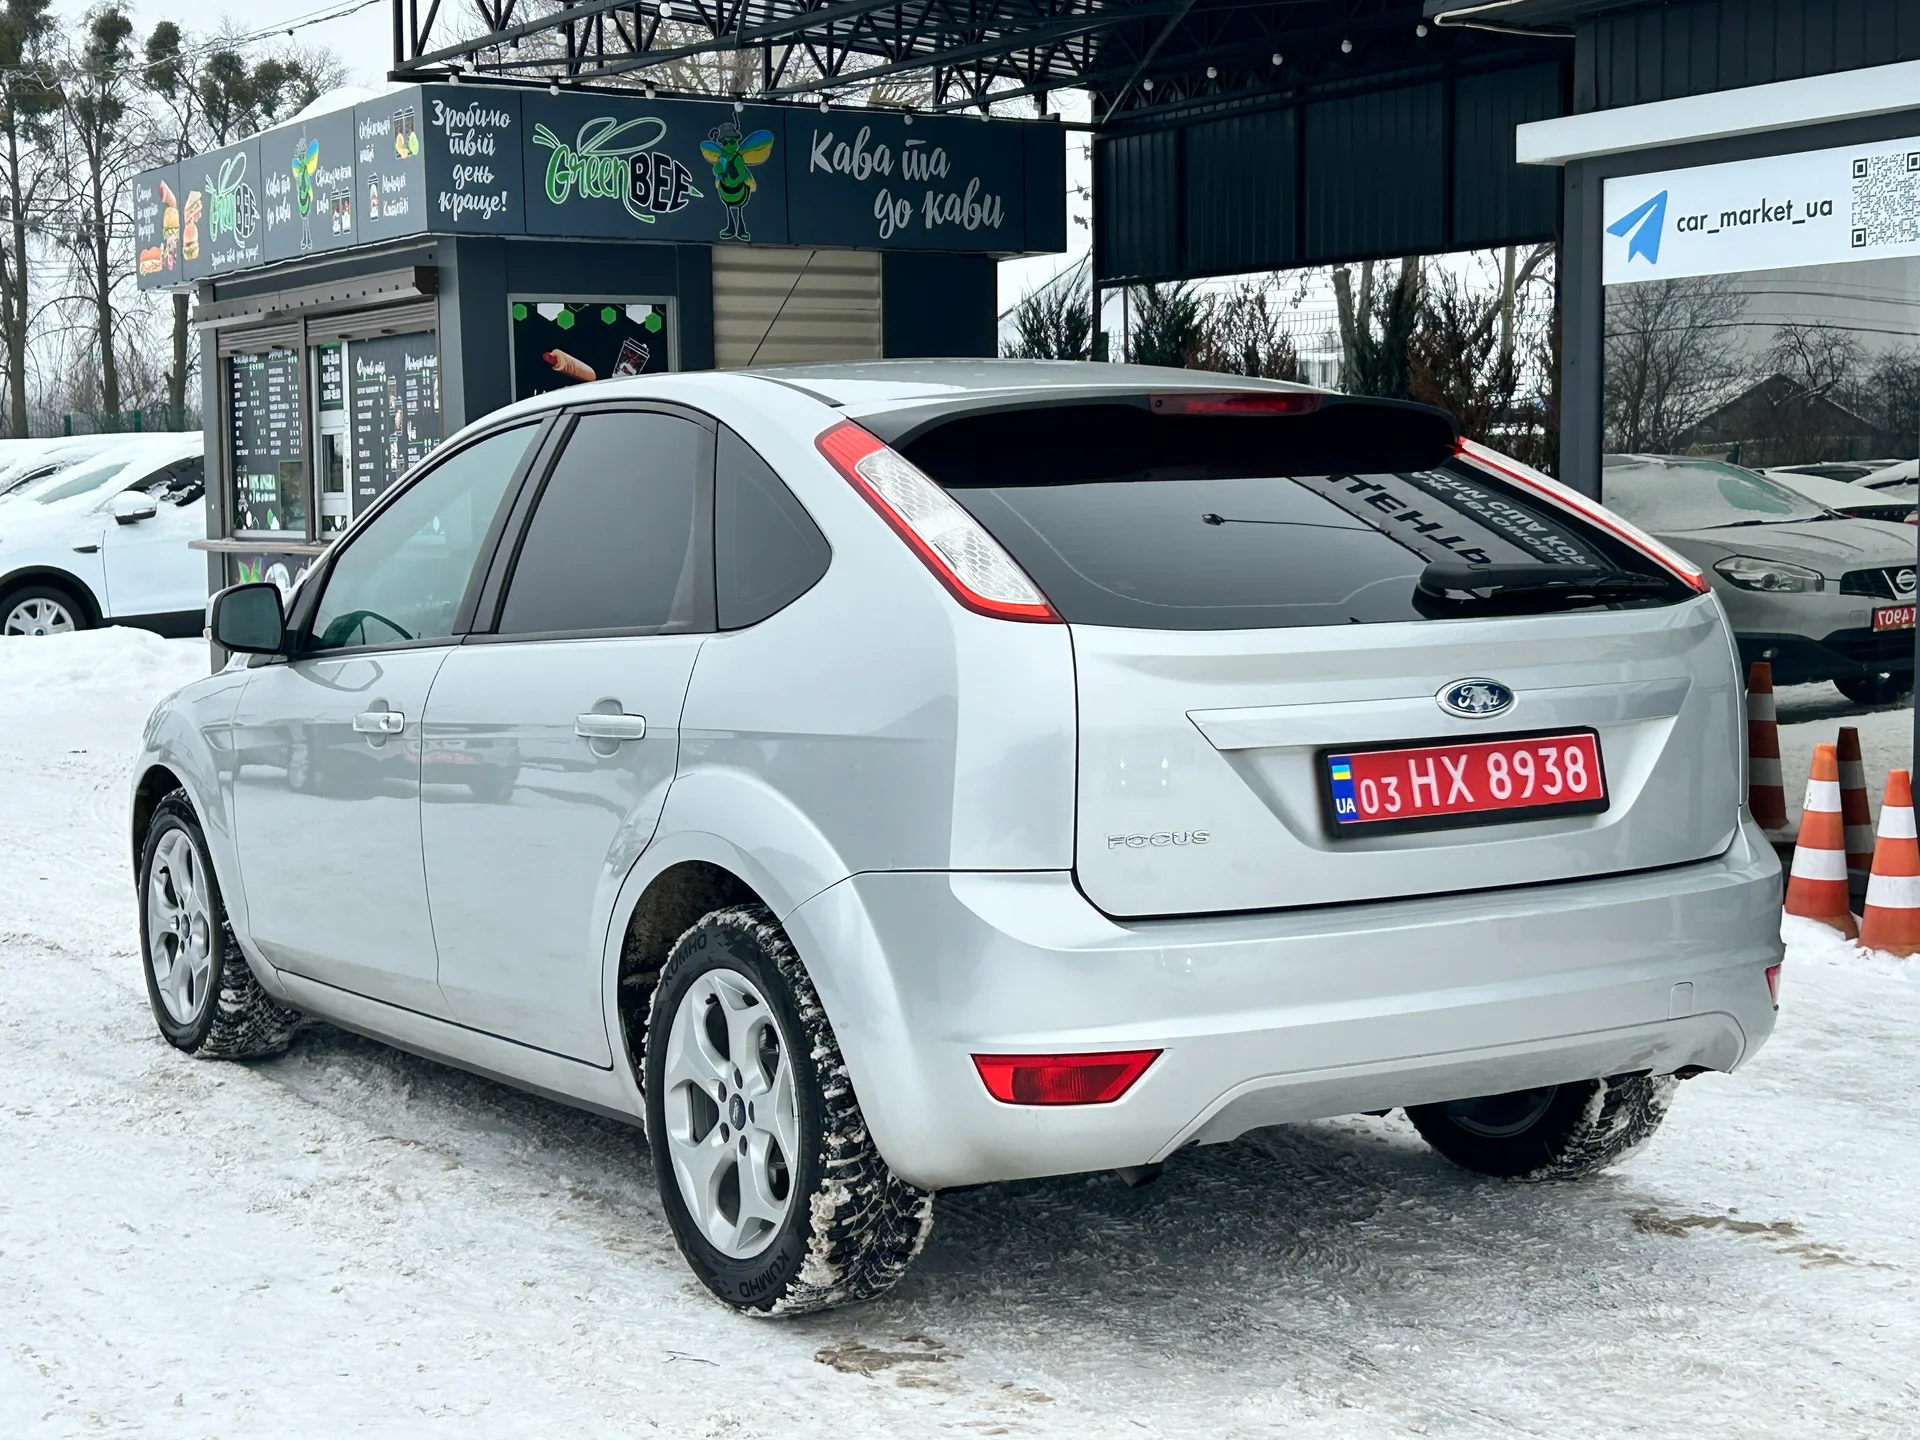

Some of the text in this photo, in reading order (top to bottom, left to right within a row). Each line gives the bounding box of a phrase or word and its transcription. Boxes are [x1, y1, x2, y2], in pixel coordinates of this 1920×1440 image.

[431, 99, 511, 135] Зробимо
[449, 128, 496, 156] твій
[810, 125, 951, 182] Кава та
[452, 163, 495, 190] день
[438, 190, 508, 221] краще!
[874, 176, 1005, 240] до кави
[1676, 197, 1834, 235] car_market_ua
[1336, 745, 1588, 815] UA 03 HX 8938
[1107, 829, 1210, 850] FOCUS
[738, 1248, 790, 1298] KUMHO
